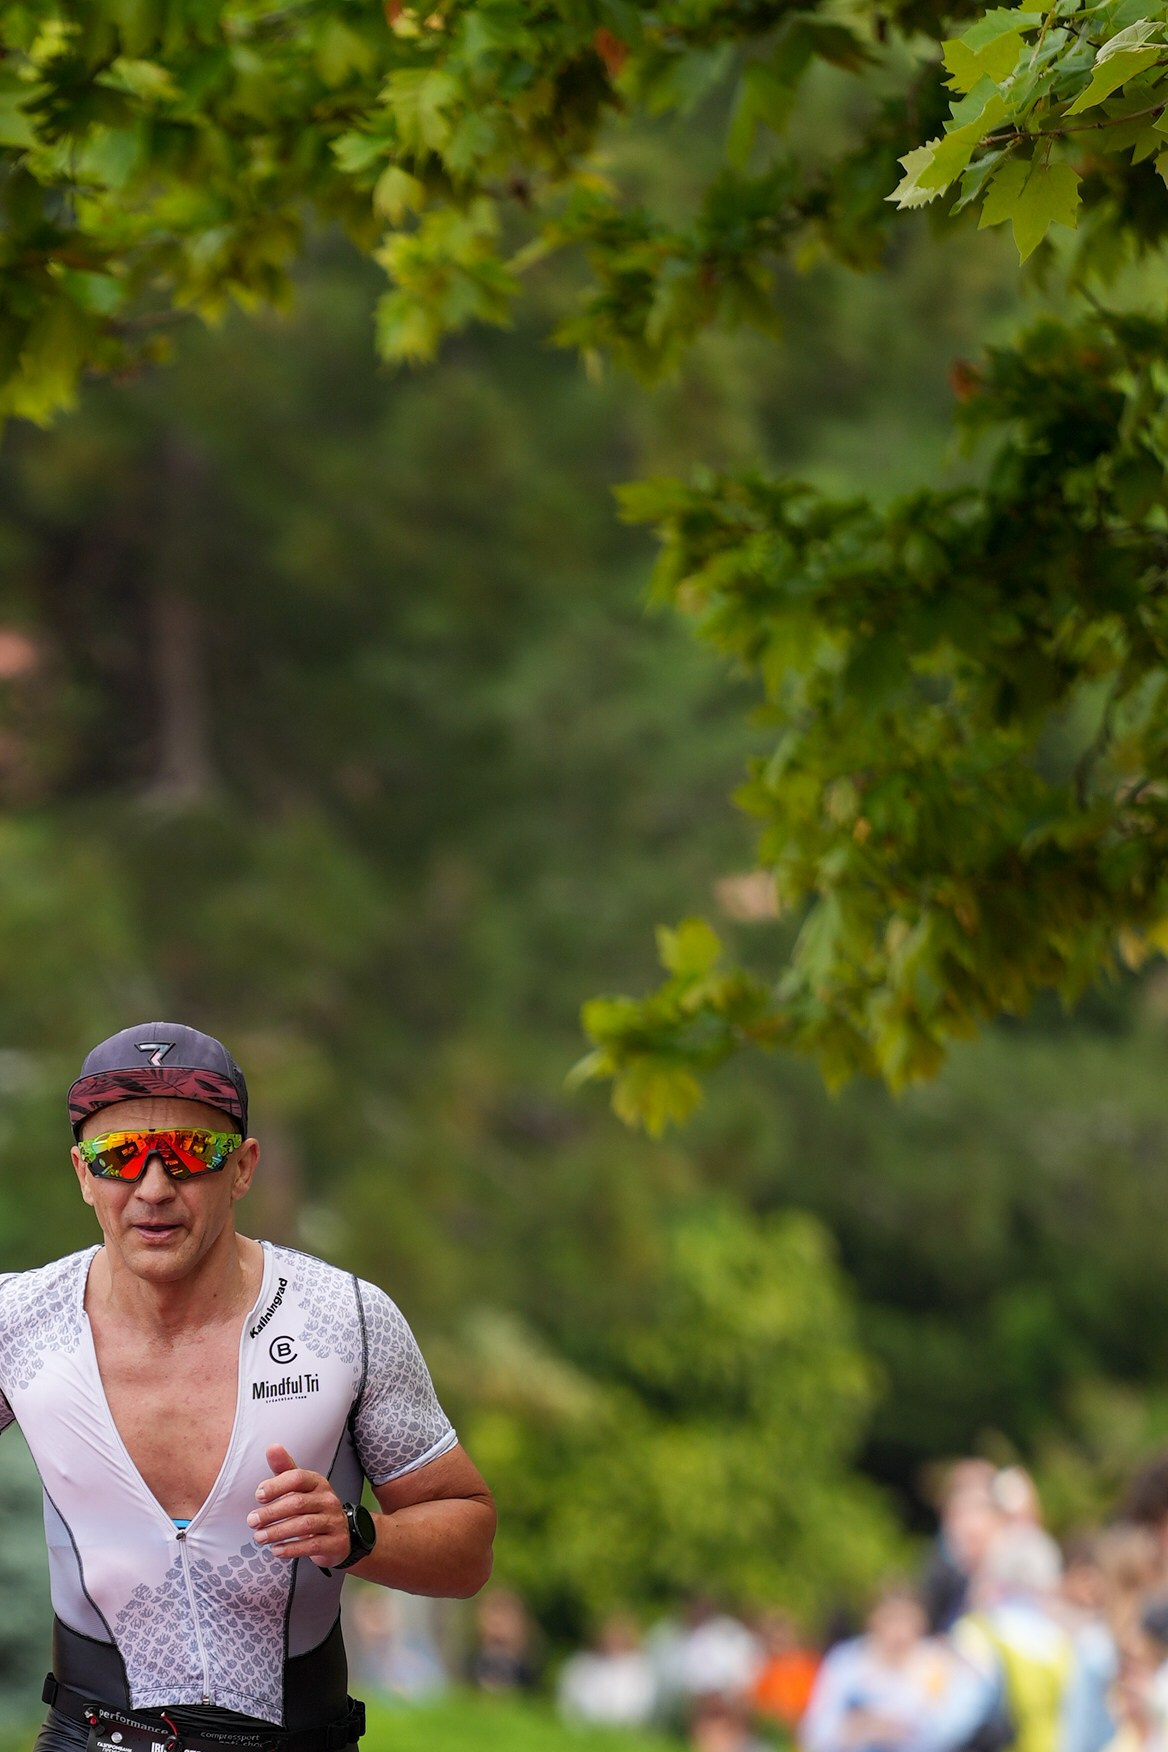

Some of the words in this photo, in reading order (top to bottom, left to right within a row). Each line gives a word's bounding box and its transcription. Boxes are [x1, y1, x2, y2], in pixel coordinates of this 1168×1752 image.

[249, 1277, 288, 1339] Kaliningrad
[252, 1374, 302, 1400] Mindful
[304, 1373, 319, 1393] Tri
[98, 1709, 169, 1735] performance
[200, 1731, 260, 1743] compressport
